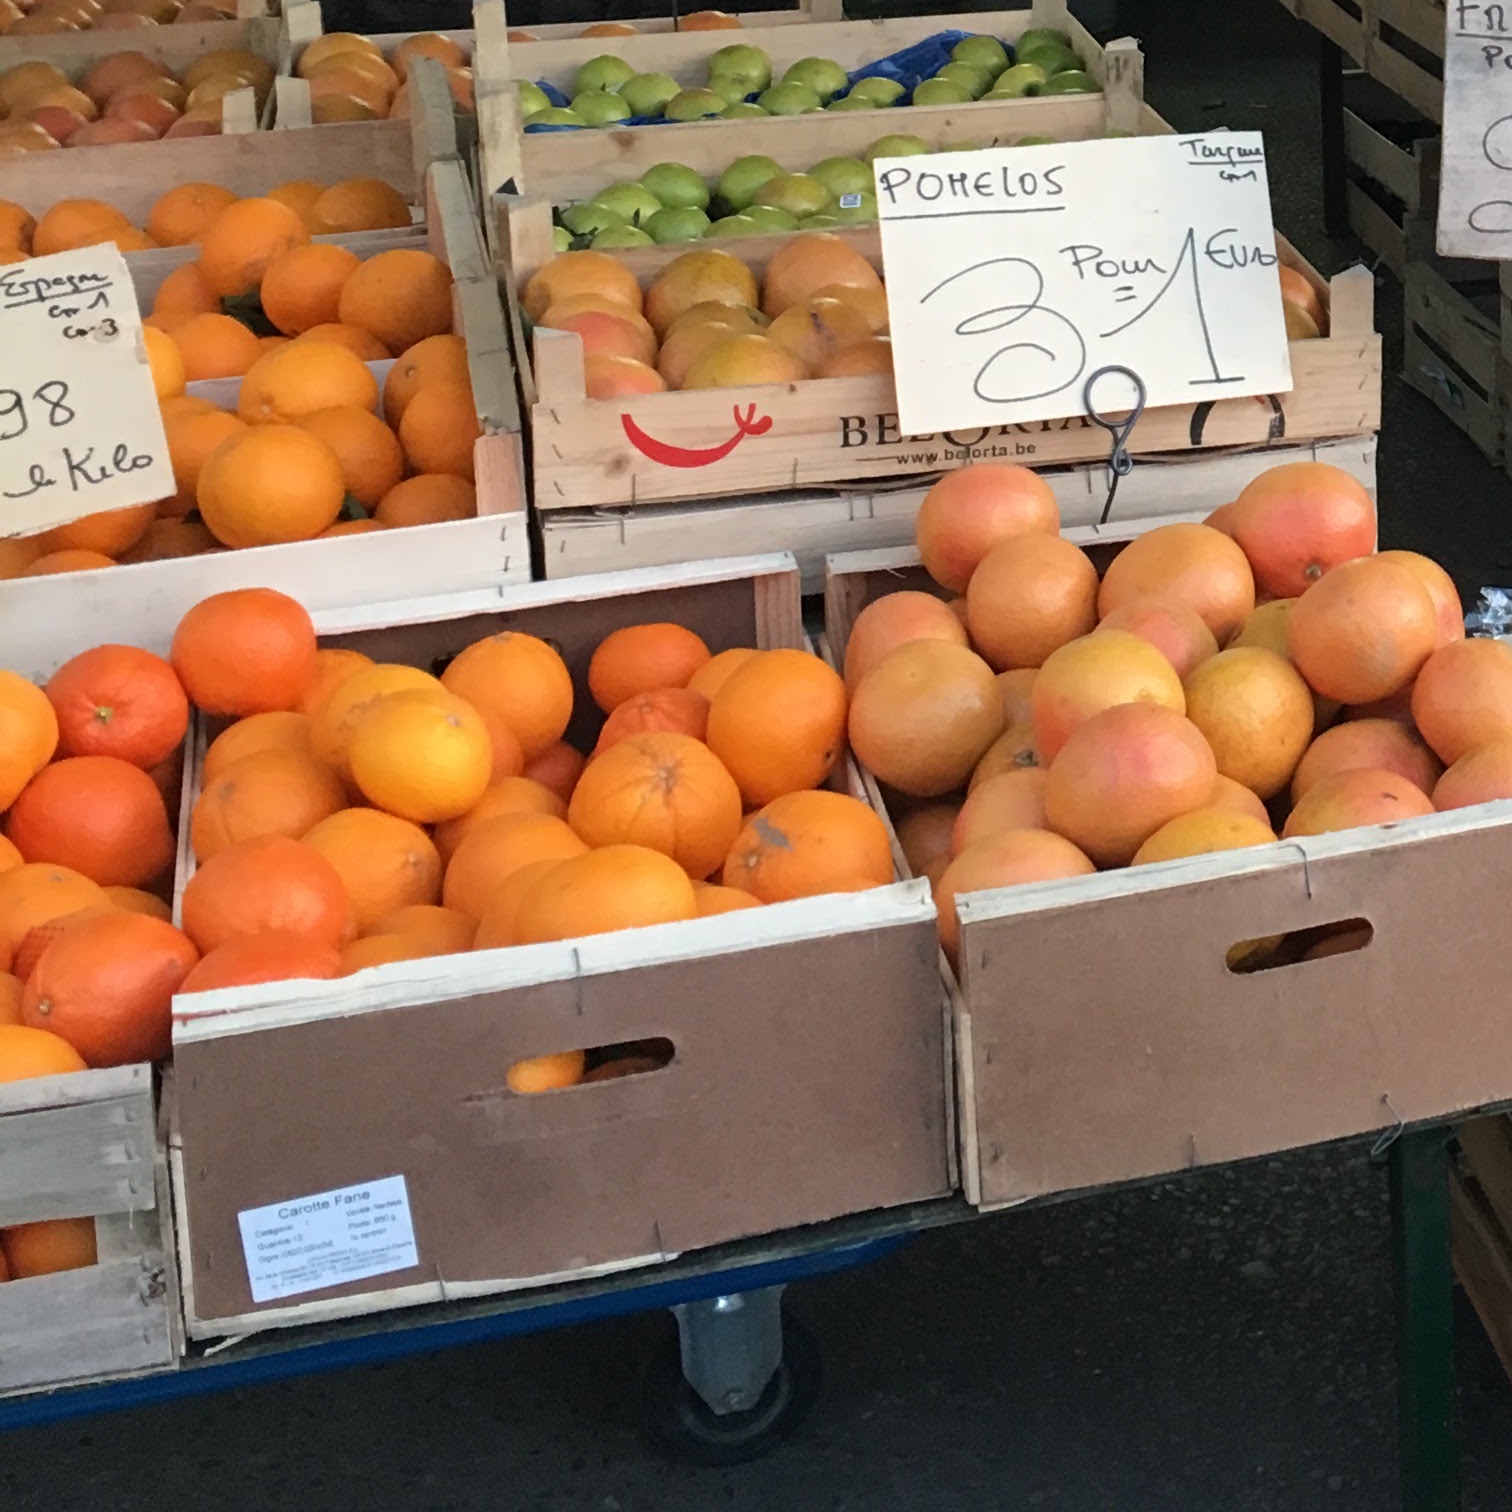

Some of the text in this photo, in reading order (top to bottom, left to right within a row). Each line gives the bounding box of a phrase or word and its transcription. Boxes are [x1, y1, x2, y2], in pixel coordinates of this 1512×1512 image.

[919, 256, 1086, 404] 3
[61, 442, 154, 492] Kilo
[896, 441, 1037, 465] www.belorta.be
[277, 1198, 331, 1220] Carotte
[334, 1190, 371, 1208] Fane
